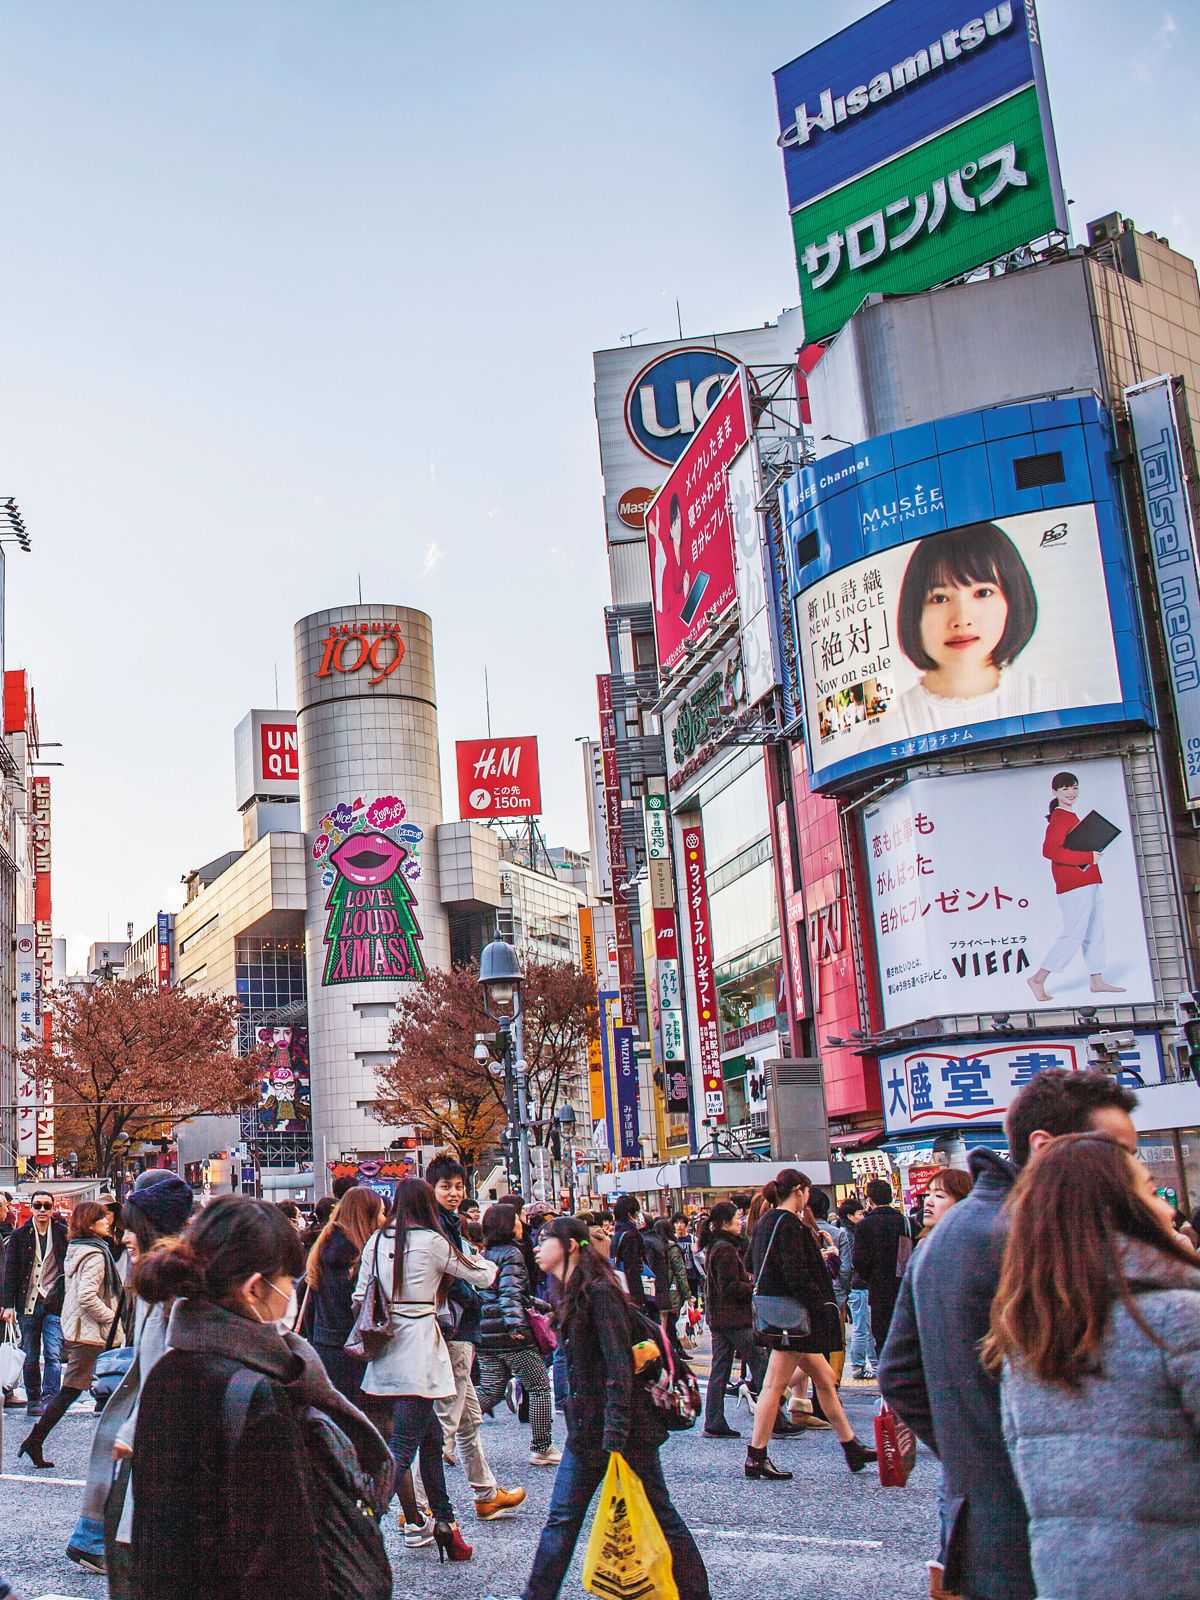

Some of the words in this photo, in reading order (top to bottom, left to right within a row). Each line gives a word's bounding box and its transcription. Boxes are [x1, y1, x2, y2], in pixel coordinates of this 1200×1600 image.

[776, 3, 1014, 149] Hisamitsu
[800, 139, 1029, 291] サロンパス
[685, 414, 734, 497] メイクしたまま
[819, 456, 871, 490] Channel
[863, 501, 945, 536] PLATINUM
[1140, 427, 1190, 570] Taisei
[807, 568, 883, 622] 新山詩織
[809, 616, 831, 638] NEW
[835, 591, 886, 624] SINGLE
[328, 622, 402, 636] SHIBUYA
[810, 610, 890, 679] 「絶対」
[1161, 576, 1200, 694] neon
[312, 633, 406, 685] 109
[815, 678, 839, 698] Now
[841, 668, 857, 684] on
[861, 654, 892, 678] sale
[267, 731, 299, 751] UN
[889, 729, 974, 757] ミュゼプラチナム
[267, 753, 299, 776] QL
[472, 746, 522, 781] H&M
[493, 786, 522, 797] この先
[494, 796, 532, 810] 150m
[871, 812, 936, 859] 恋も仕事も
[657, 861, 666, 902] Euphoria
[876, 853, 935, 897] がんばった
[344, 888, 396, 910] LOVE!
[879, 885, 1030, 937] 自分にプレゼント。
[339, 908, 404, 938] LOUD!
[657, 927, 675, 940] JTB
[688, 863, 711, 1009] ウィンターフルーツギフト
[949, 934, 1028, 950] プライベート・ビエラ
[332, 936, 415, 981] XMAS!
[951, 947, 1031, 979] VIERA
[669, 969, 679, 996] フルーツ
[621, 1037, 630, 1077] MIZUHO
[664, 1023, 673, 1051] フルーツ
[707, 1020, 722, 1079] 無料配送地域
[622, 1104, 635, 1148] みずほ銀行
